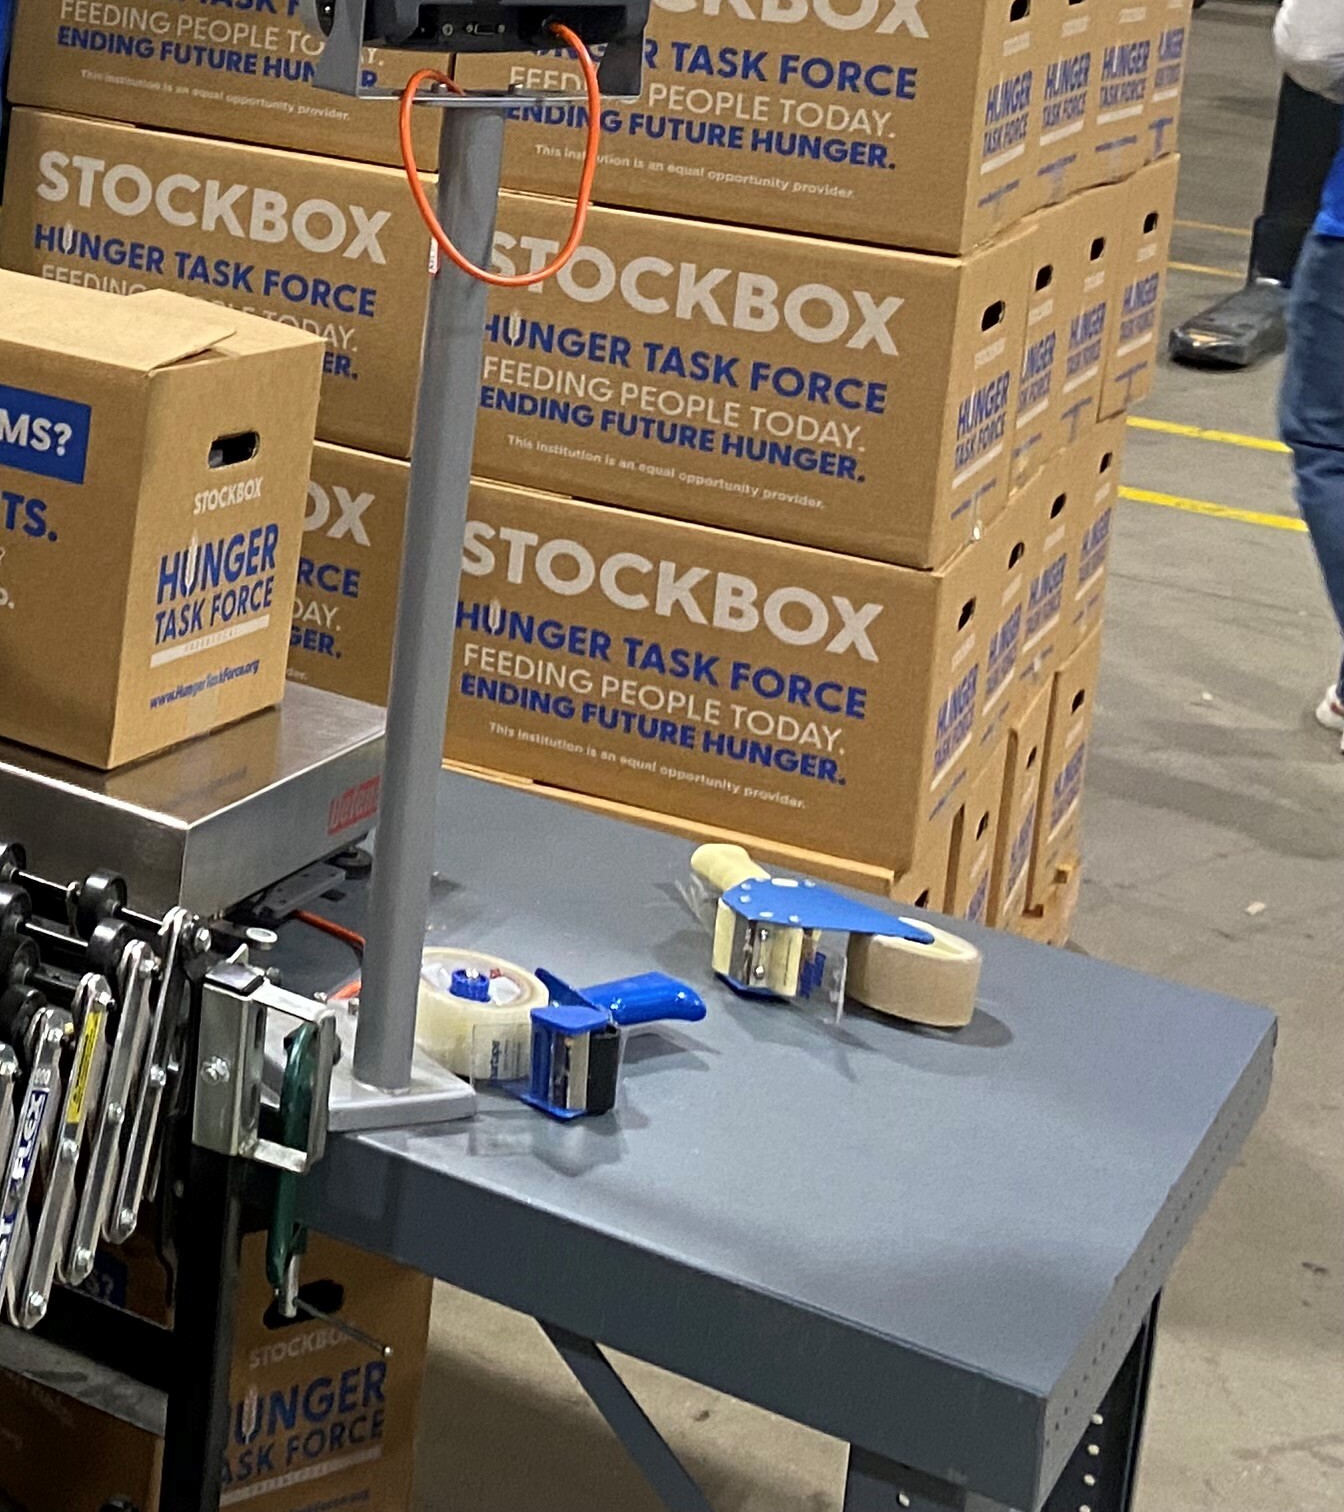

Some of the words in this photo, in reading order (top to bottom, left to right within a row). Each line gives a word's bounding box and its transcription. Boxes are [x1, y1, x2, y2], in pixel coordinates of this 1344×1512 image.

[57, 26, 155, 59] ENDING
[159, 41, 257, 75] FUTURE
[177, 14, 280, 51] PEOPLE
[1100, 40, 1150, 81] HUNGER
[671, 41, 768, 83] TASK
[779, 54, 918, 100] FORCE
[985, 70, 1032, 126] HUNGER
[1044, 52, 1091, 100] HUNGER
[226, 94, 295, 116] opportunity
[297, 104, 350, 121] provider.
[628, 112, 744, 150] FUTURE
[750, 129, 896, 171] HUNGER.
[648, 82, 771, 122] PEOPLE
[780, 99, 896, 138] TODAY.
[535, 144, 561, 158] This
[633, 158, 645, 169] is
[647, 161, 664, 171] an
[666, 161, 704, 180] equal
[707, 168, 789, 192] opportunity
[792, 178, 855, 199] provider.
[37, 150, 392, 265] STOCKBOX
[34, 220, 164, 274] HUNGER
[174, 251, 254, 294] TASK
[263, 269, 377, 317] FORCE
[490, 230, 904, 356] STOCKBOX
[485, 312, 631, 369] HUNGER
[643, 341, 740, 388] TASK
[750, 360, 888, 415] FORCE
[480, 386, 594, 428] ENDING
[600, 409, 714, 453] FUTURE
[721, 435, 866, 484] HUNGER.
[483, 356, 613, 402] FEEDING
[619, 381, 740, 429] PEOPLE
[749, 405, 866, 453] TODAY.
[957, 370, 1010, 441] HUNGER
[193, 477, 263, 515] STOCKBOX
[507, 433, 534, 450] This
[536, 438, 602, 464] institution
[605, 452, 616, 466] is
[619, 457, 636, 470] an
[639, 459, 676, 479] equal
[678, 468, 759, 498] opportunity
[762, 487, 825, 510] provider.
[156, 523, 279, 605] HUNGER
[298, 557, 360, 598] RCE
[461, 520, 884, 663] STOCKBOX
[153, 595, 206, 645] TASK
[210, 574, 274, 628] FORCE
[289, 625, 342, 659] GER.
[292, 599, 341, 631] DAY.
[456, 597, 611, 661] HUNGER
[623, 636, 720, 686] TASK
[729, 660, 867, 719] FORCE
[460, 674, 576, 720] ENDING
[581, 701, 695, 750] FUTURE
[702, 732, 846, 786] HUNGER.
[463, 643, 593, 693] FEEDING
[601, 676, 721, 726] PEOPLE
[729, 704, 845, 755] TODAY.
[489, 721, 514, 739] This
[517, 727, 584, 756] institution
[586, 744, 597, 758] is
[600, 749, 616, 762] an
[620, 754, 655, 774] equal
[659, 764, 741, 795] opportunity
[742, 786, 806, 810] provider.
[230, 1360, 387, 1446] UNGER
[221, 1442, 275, 1486] ASK
[286, 1410, 384, 1465] FORCE
